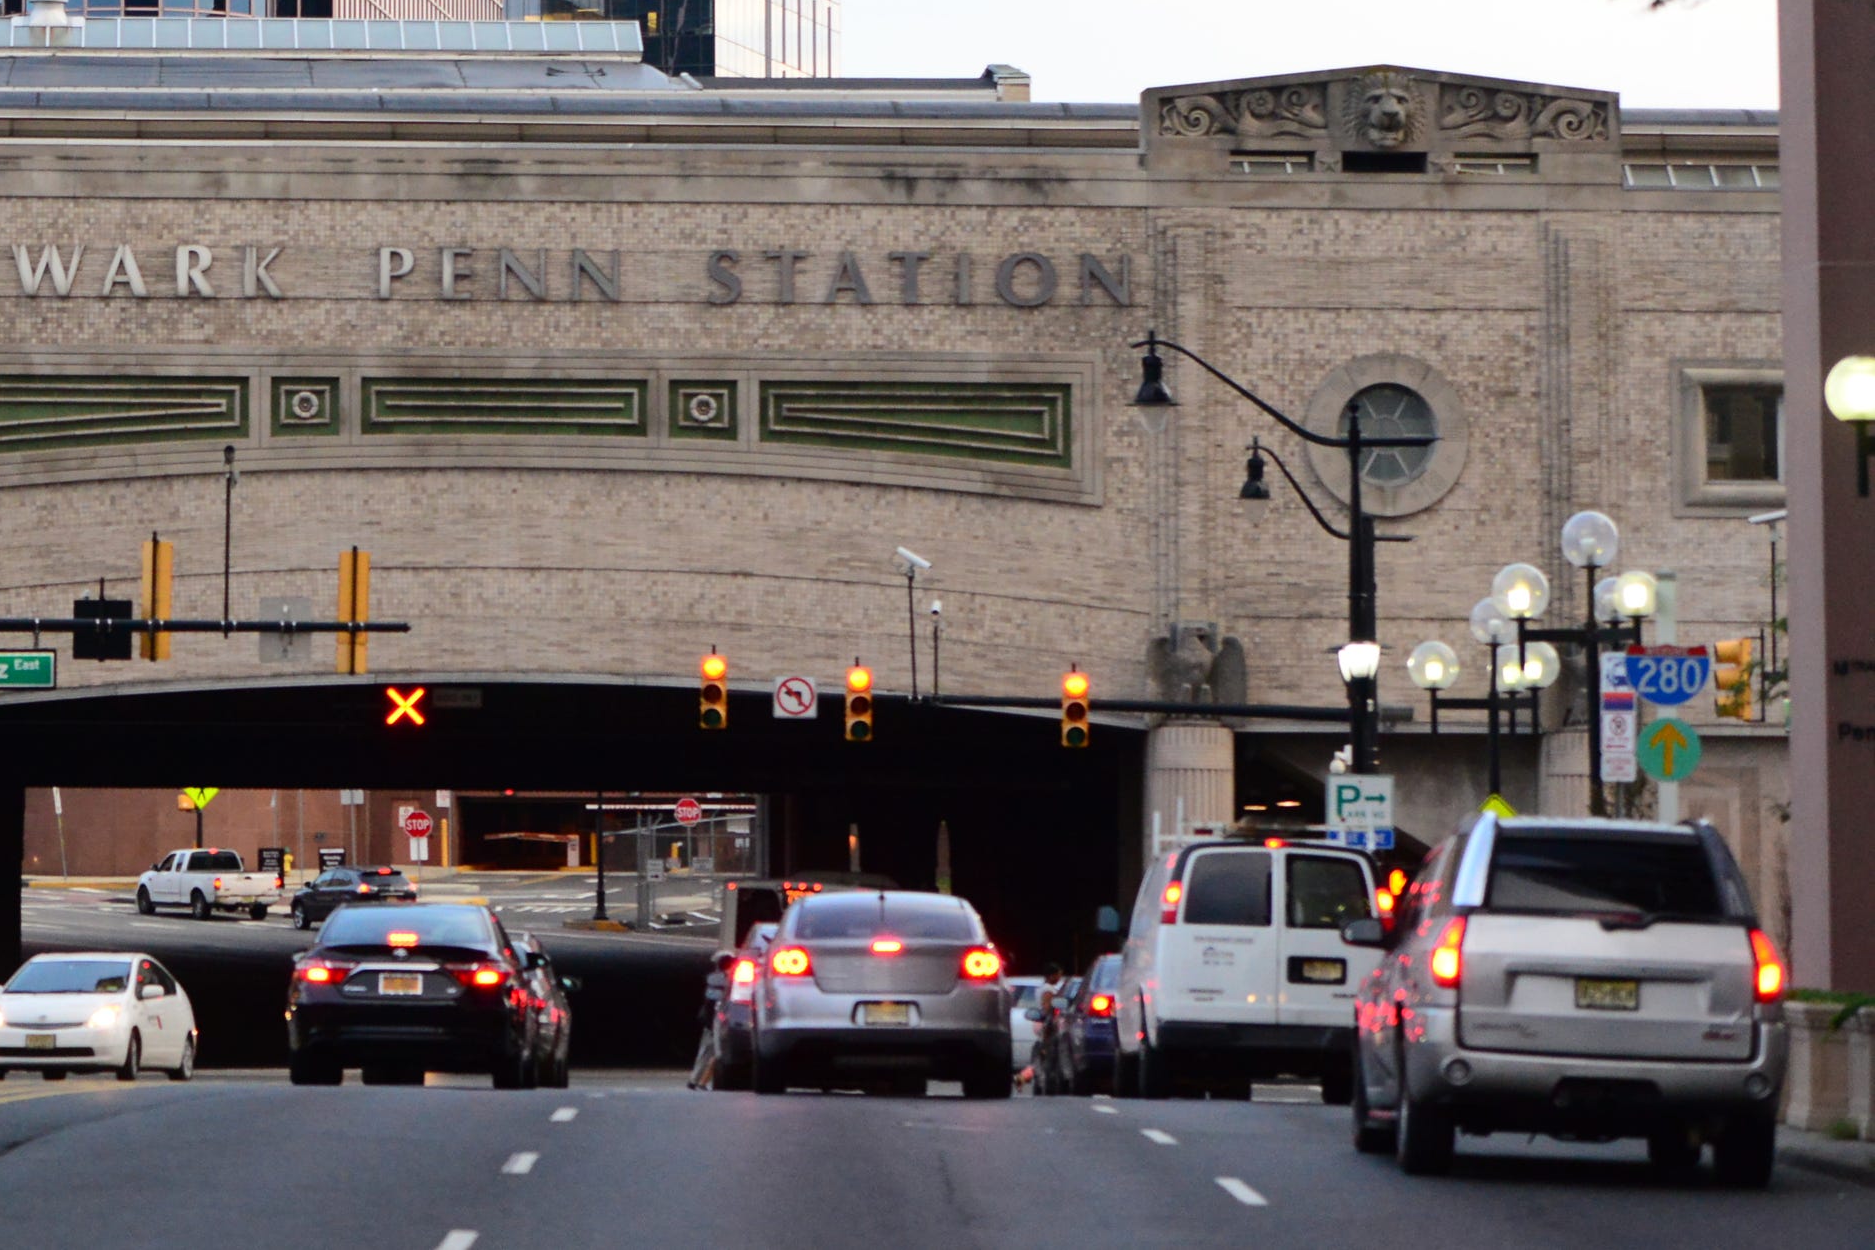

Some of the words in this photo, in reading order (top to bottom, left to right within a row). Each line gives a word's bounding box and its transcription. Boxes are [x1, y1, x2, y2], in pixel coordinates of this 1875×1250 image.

[378, 247, 620, 301] PENN
[707, 250, 1131, 307] STATION
[14, 660, 40, 670] East
[1638, 658, 1702, 694] 280
[1336, 785, 1361, 817] P
[676, 808, 701, 819] STOP
[406, 819, 430, 831] STOP
